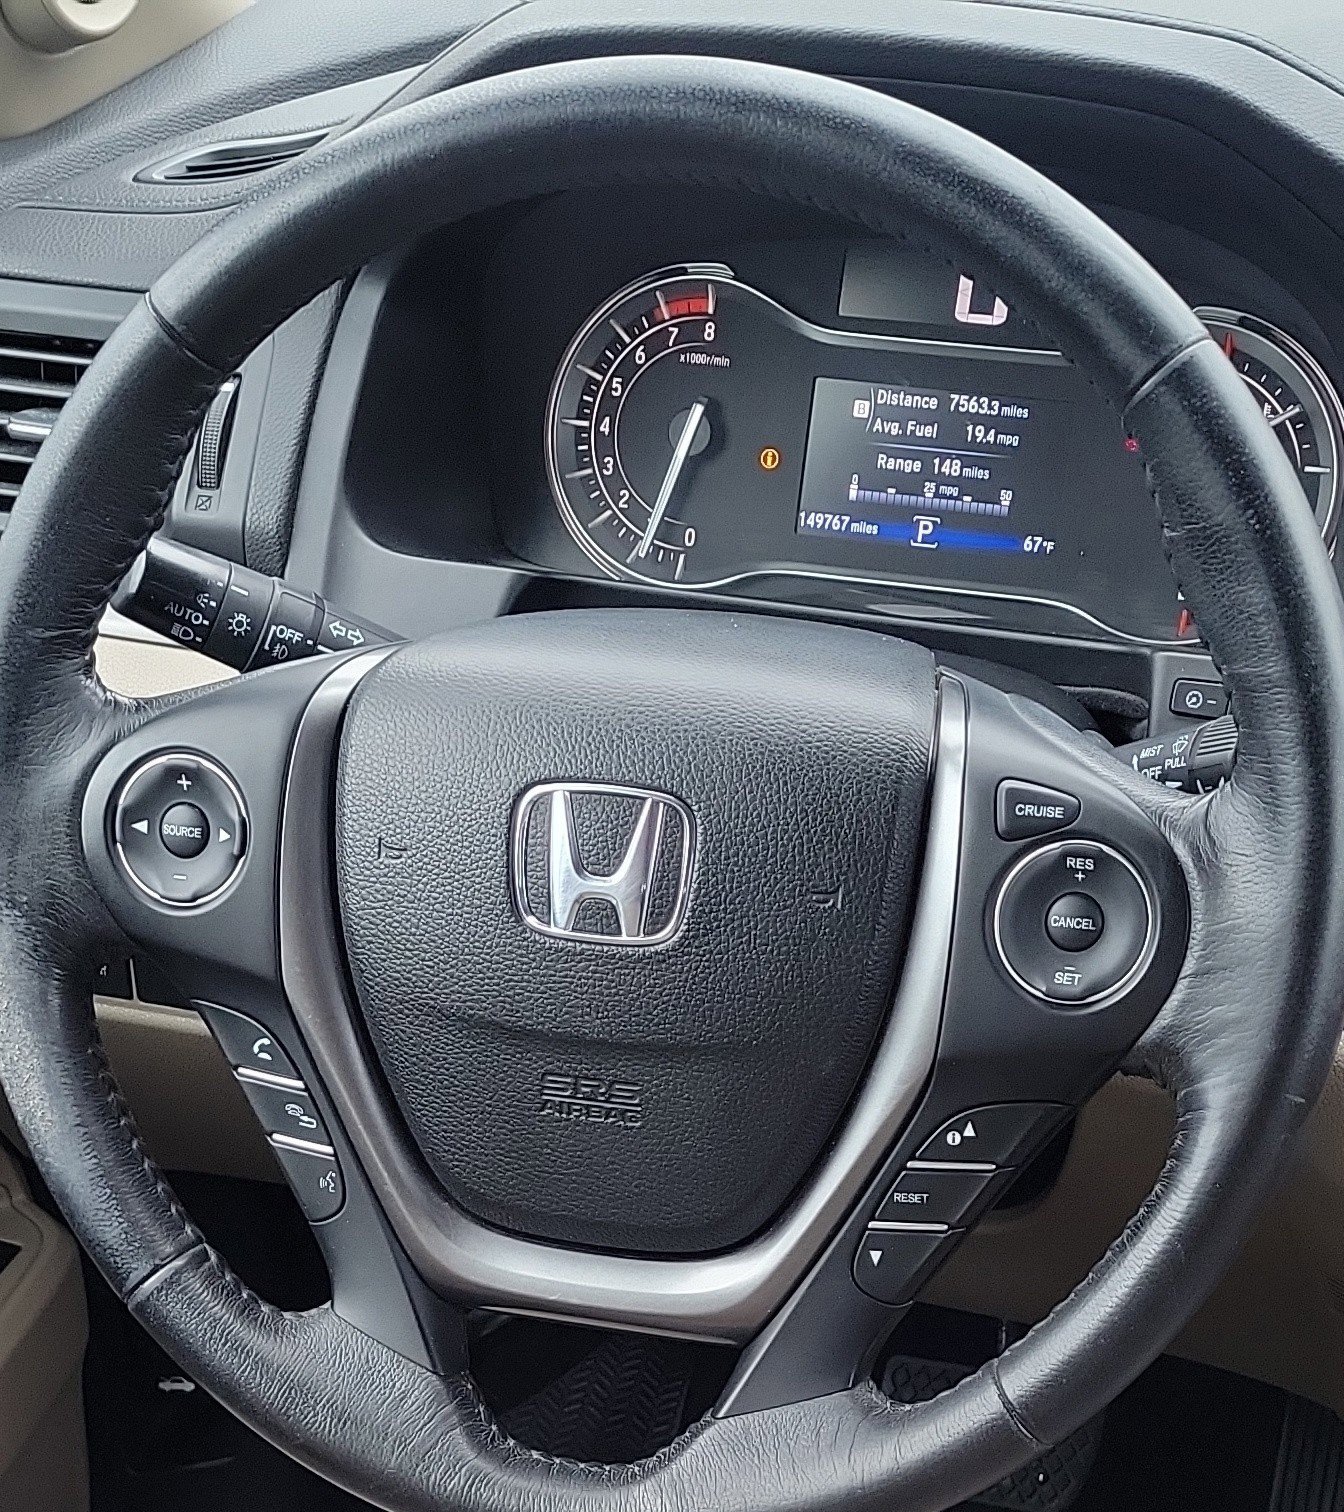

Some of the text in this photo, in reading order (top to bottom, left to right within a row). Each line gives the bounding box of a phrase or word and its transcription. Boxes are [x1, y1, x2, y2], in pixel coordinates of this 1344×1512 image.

[668, 327, 679, 346] 7
[704, 322, 716, 341] 8
[635, 345, 646, 365] 6
[679, 352, 731, 368] x1000r/min
[611, 377, 622, 397] 5
[877, 388, 1029, 419] Distance 7563.3 miles
[600, 416, 610, 436] 4
[872, 417, 1020, 447] Avg. Fuel 19.4 mpg
[602, 456, 613, 475] 3
[877, 453, 990, 480] Range 148 miles
[924, 481, 959, 497] 25 mpg
[999, 490, 1013, 501] 50
[618, 490, 630, 508] 2
[799, 510, 879, 536] 149767 miles
[917, 520, 934, 543] P
[684, 527, 696, 547] 0
[164, 602, 202, 625] AUTO
[276, 625, 304, 644] OFF
[1140, 745, 1164, 759] MIST
[1165, 756, 1186, 770] PULL
[1015, 803, 1065, 819] CRUISE
[163, 822, 202, 839] SOURCE
[1066, 857, 1094, 871] RES
[1050, 915, 1097, 931] CANCEL
[1053, 972, 1083, 987] SET
[541, 1073, 643, 1103] SRS
[539, 1100, 642, 1127] AIRBAG
[893, 1192, 930, 1205] RESET
